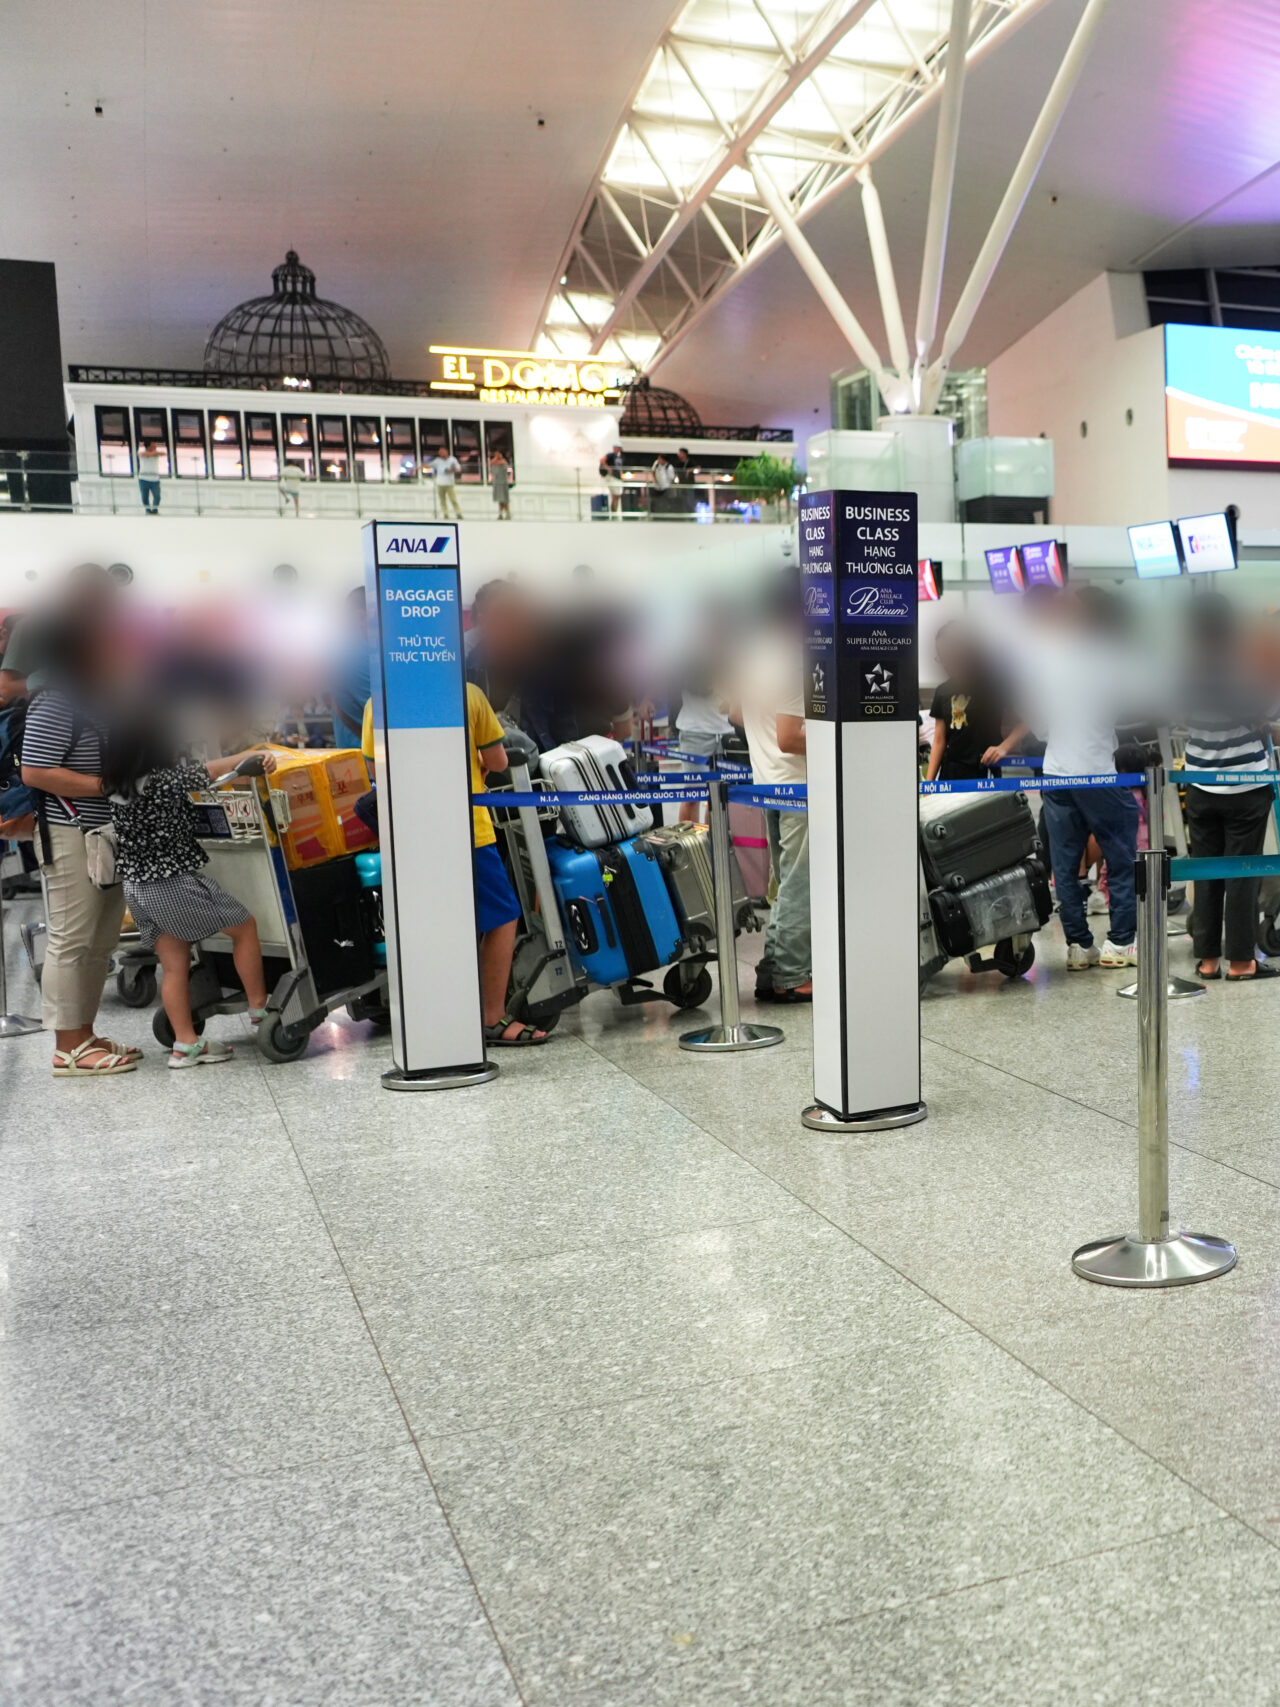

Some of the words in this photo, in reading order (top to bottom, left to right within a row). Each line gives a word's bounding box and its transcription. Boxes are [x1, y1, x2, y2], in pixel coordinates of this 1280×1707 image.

[443, 355, 476, 380] EL
[482, 358, 608, 393] DOMO
[479, 388, 567, 406] RESTAURANT
[801, 506, 831, 522] BUSINESS
[845, 506, 911, 522] BUSINESS
[805, 526, 825, 541] CLASS
[856, 527, 900, 541] CLASS
[386, 538, 428, 553] ANA
[864, 546, 896, 560] HẠNG
[845, 561, 893, 575] THƯƠNG
[895, 564, 913, 575] GIA
[385, 589, 454, 601] BAGGAGE
[847, 586, 909, 616] Platinum
[401, 606, 440, 617] DROP
[397, 634, 422, 647] THỦ
[423, 636, 446, 648] TỤC
[846, 637, 868, 645] SUPER
[868, 637, 891, 645] FLYERS
[388, 651, 419, 664] TRỰC
[420, 649, 456, 662] TUYẾN
[812, 704, 826, 714] GOLD
[864, 705, 895, 714] GOLD
[637, 774, 651, 784] NỘI
[977, 781, 995, 789] N.I.A
[1020, 779, 1041, 787] NOIBAI
[1043, 777, 1089, 787] INTERNATIONAL
[1090, 775, 1117, 785] AIRPORT
[624, 791, 651, 800] KHÔNG
[652, 791, 674, 799] QUỐC
[675, 790, 685, 798] TẾ
[686, 790, 699, 800] NỘI
[700, 789, 709, 797] BÀ
[774, 787, 794, 795] N.I.A
[924, 783, 937, 794] NỘI
[939, 782, 952, 792] BÀI
